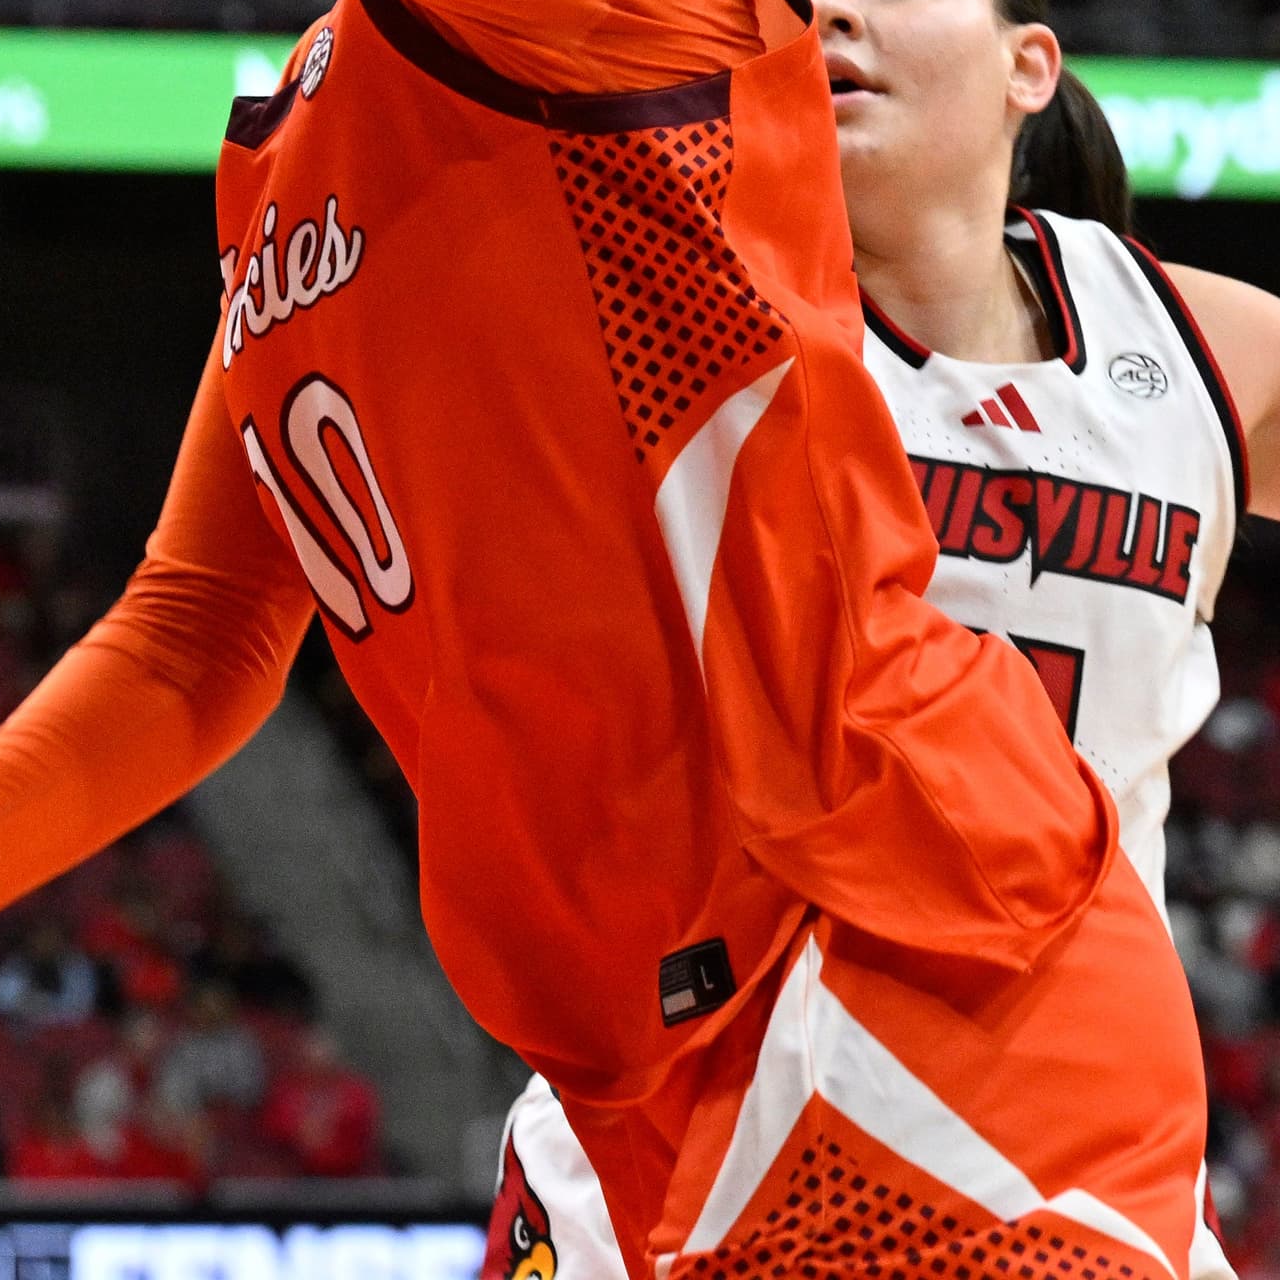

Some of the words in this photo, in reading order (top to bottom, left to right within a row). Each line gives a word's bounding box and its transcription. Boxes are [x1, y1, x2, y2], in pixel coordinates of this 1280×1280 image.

[219, 195, 366, 372] kies
[239, 370, 417, 645] 10
[907, 453, 1201, 607] UISVILLE
